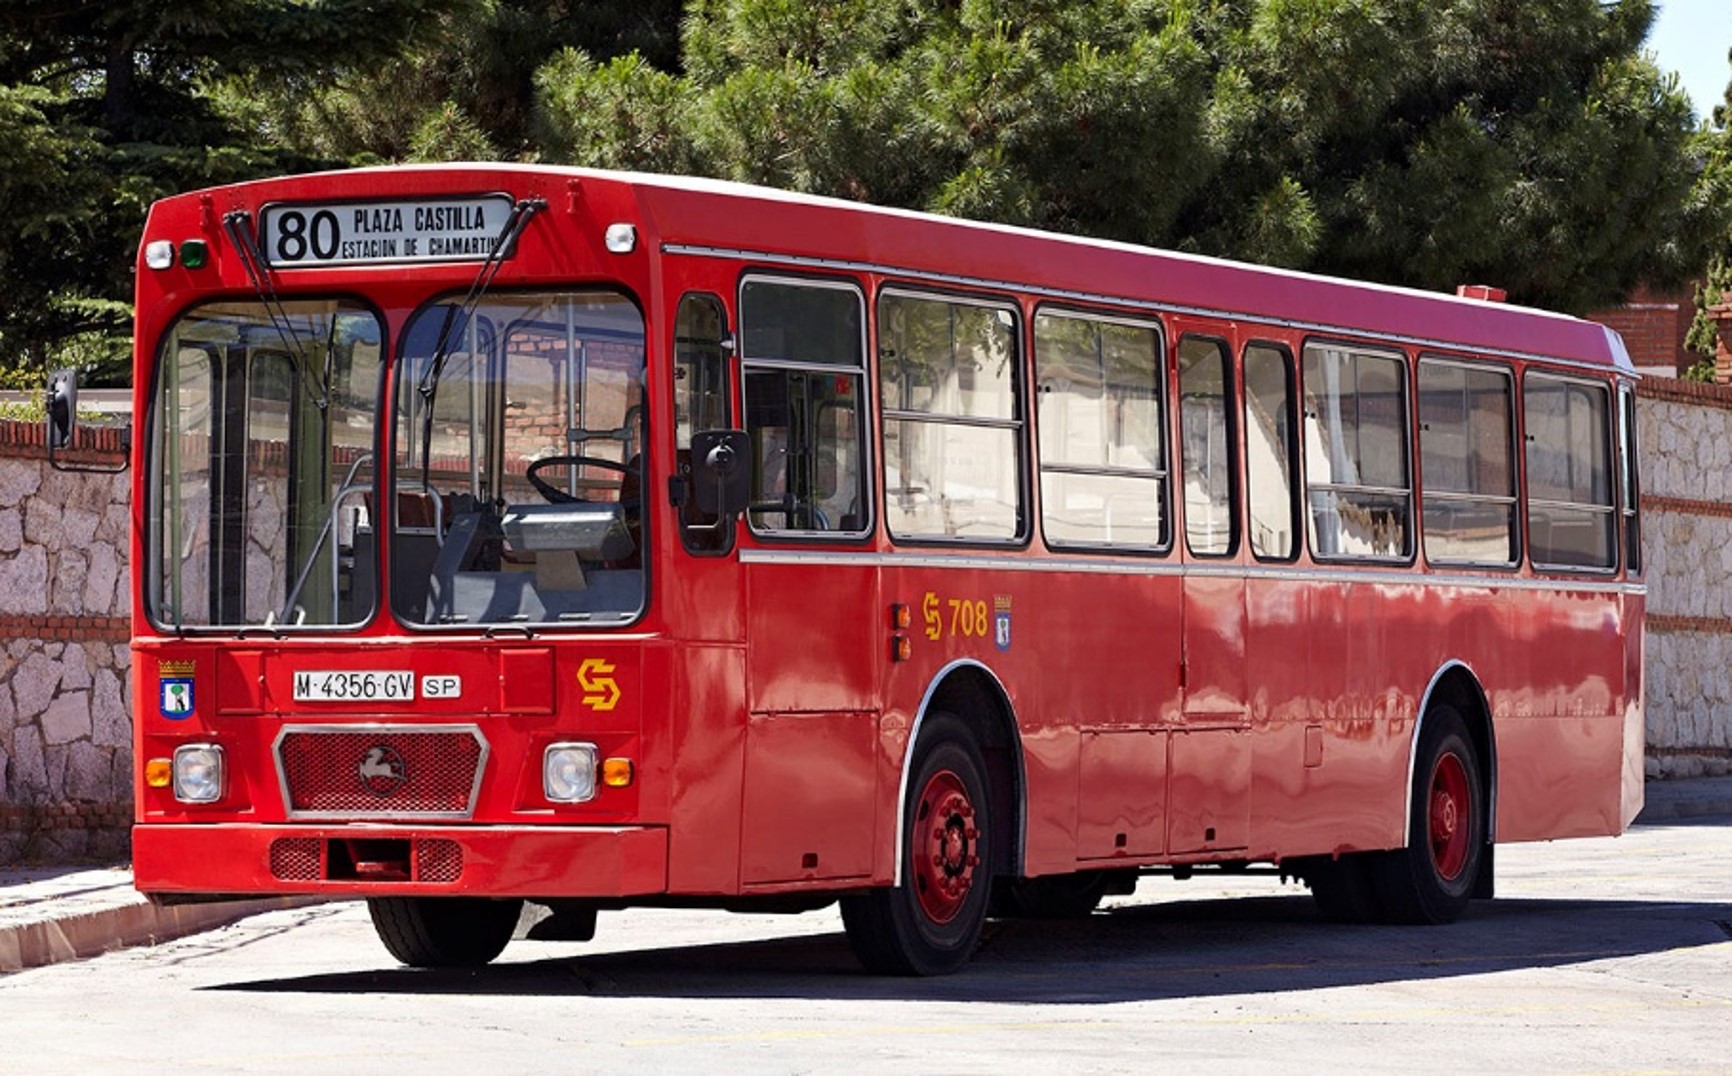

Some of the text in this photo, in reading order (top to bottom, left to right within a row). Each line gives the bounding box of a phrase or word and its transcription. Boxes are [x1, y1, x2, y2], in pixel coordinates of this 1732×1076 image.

[354, 206, 484, 233] PLAZA CASTILLA
[277, 210, 340, 261] 80
[405, 239, 417, 255] DE
[948, 599, 988, 637] 708
[425, 679, 456, 695] SP
